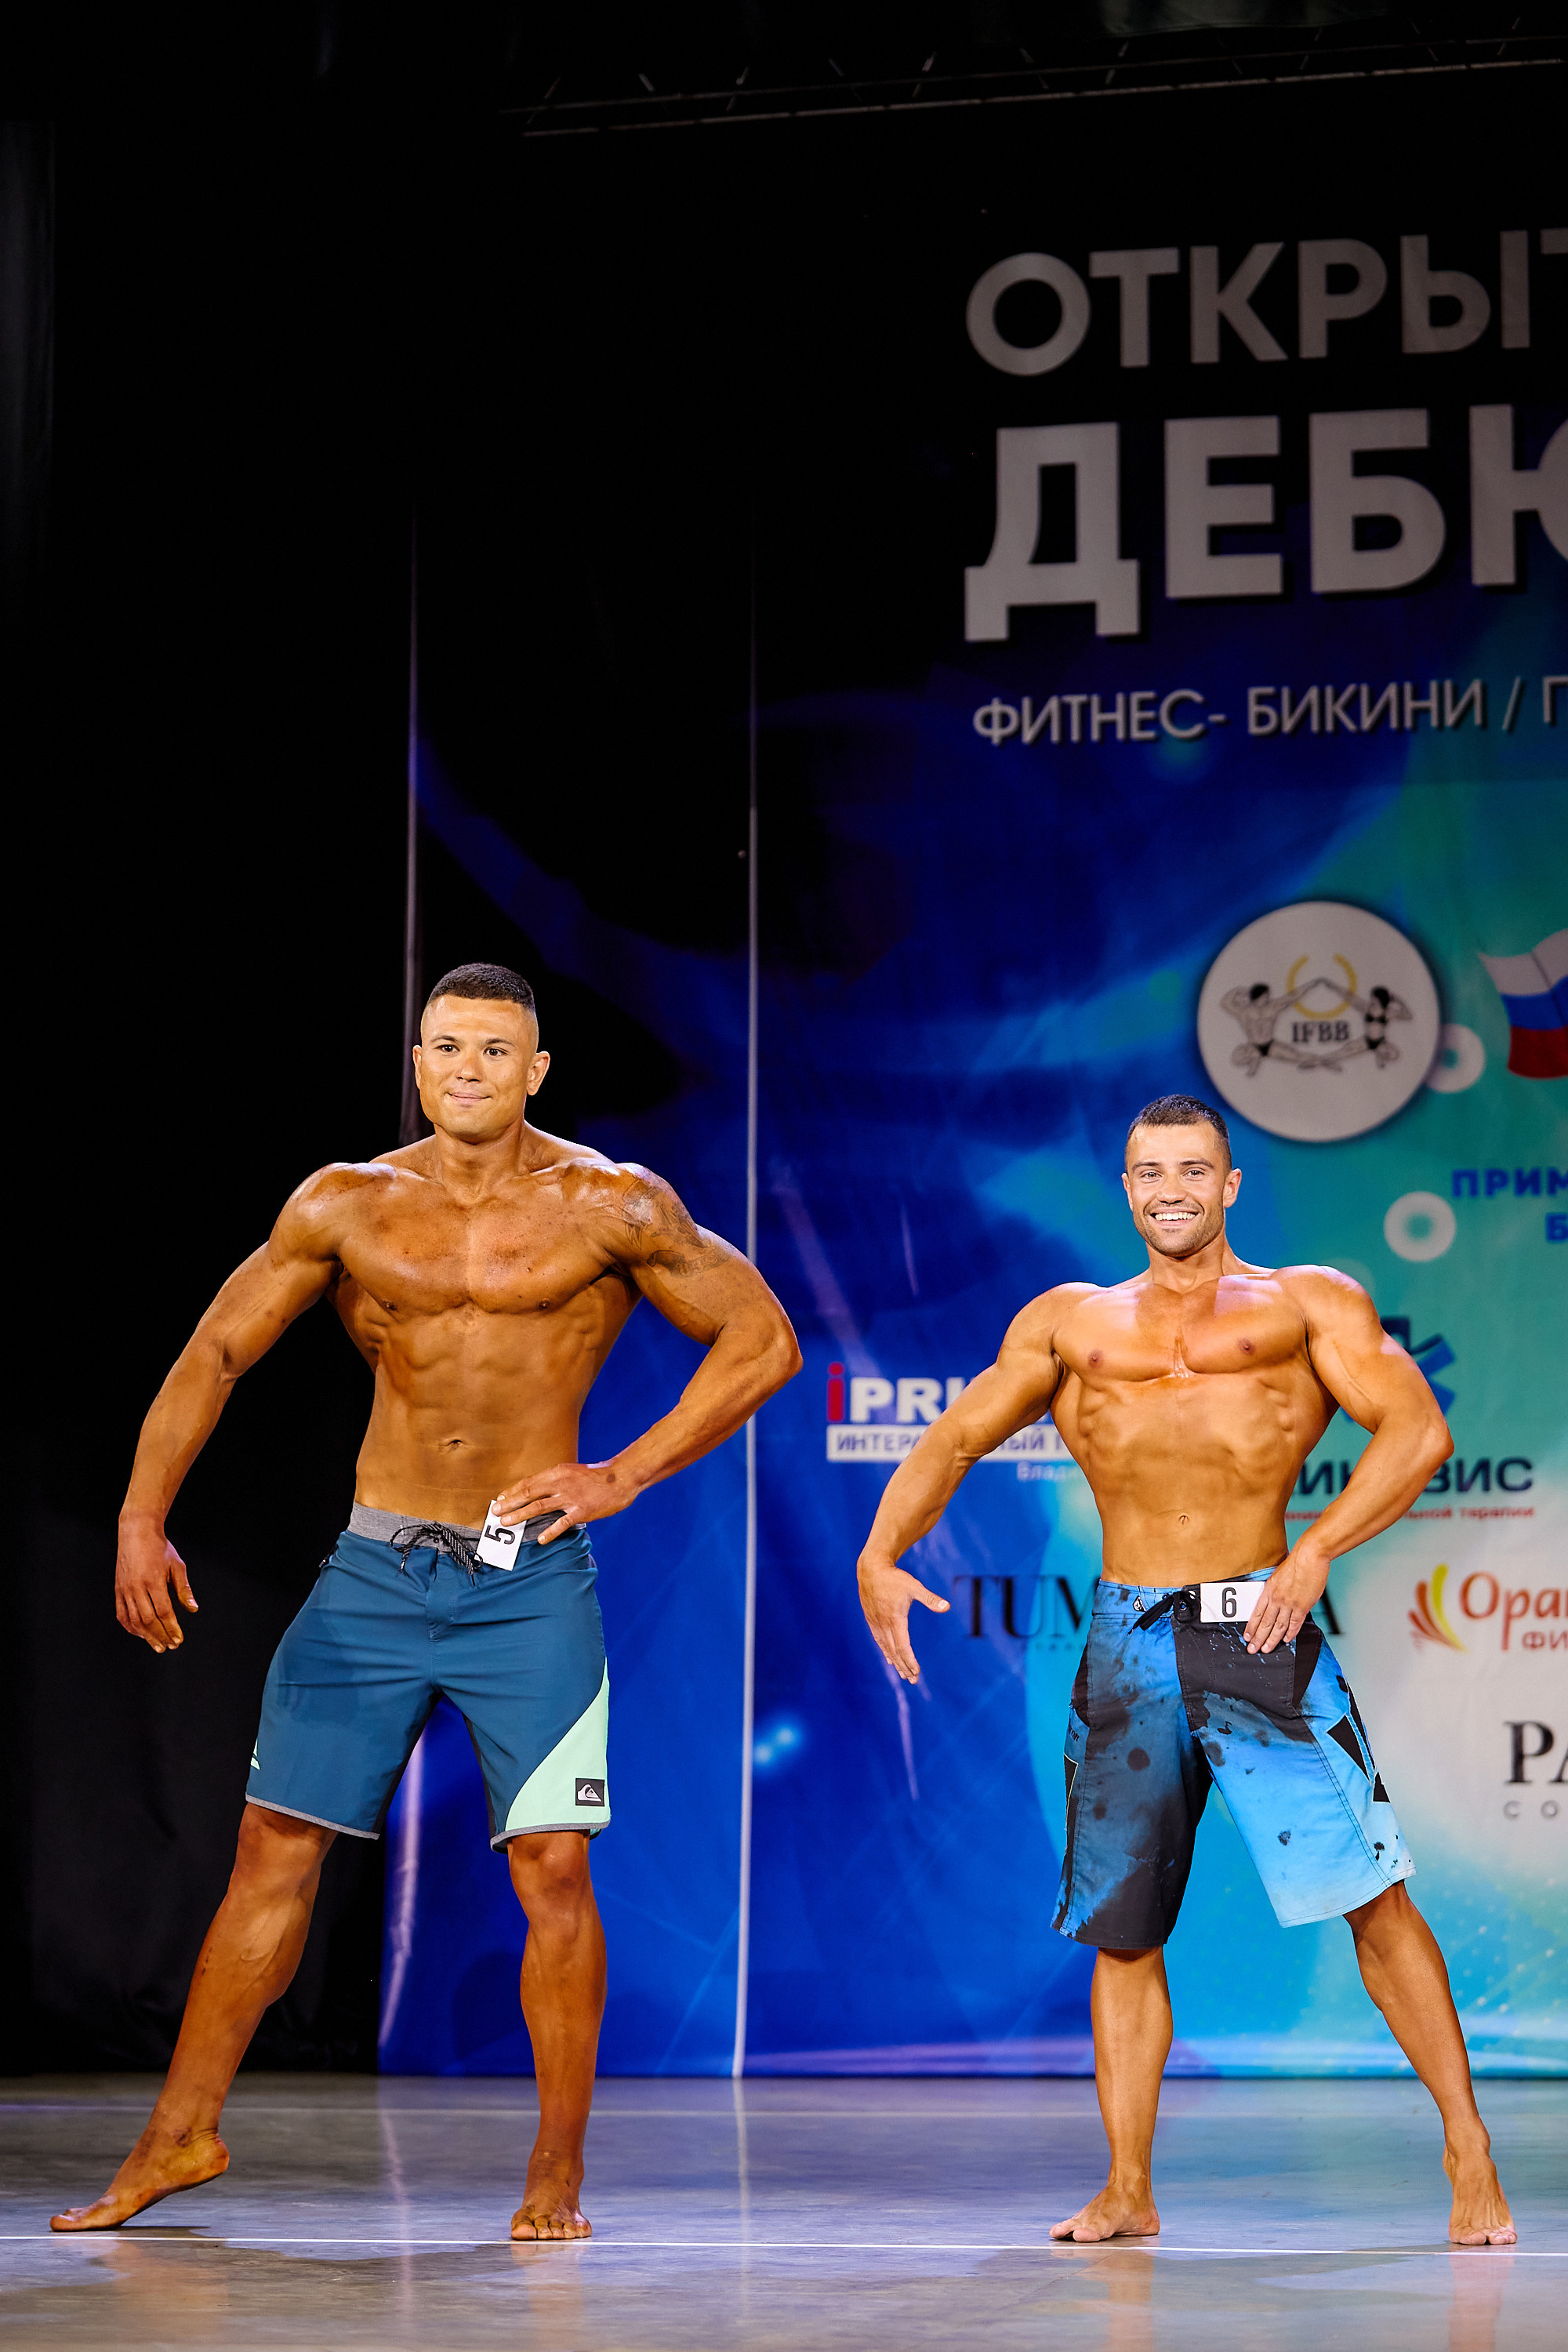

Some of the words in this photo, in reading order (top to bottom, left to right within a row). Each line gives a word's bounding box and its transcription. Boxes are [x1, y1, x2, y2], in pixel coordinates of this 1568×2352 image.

[1247, 678, 1483, 735] БИКИНИ
[1291, 1021, 1349, 1043] IFBB
[485, 1525, 516, 1545] 5
[1221, 1587, 1237, 1618] 6
[1458, 1571, 1568, 1652] Ора
